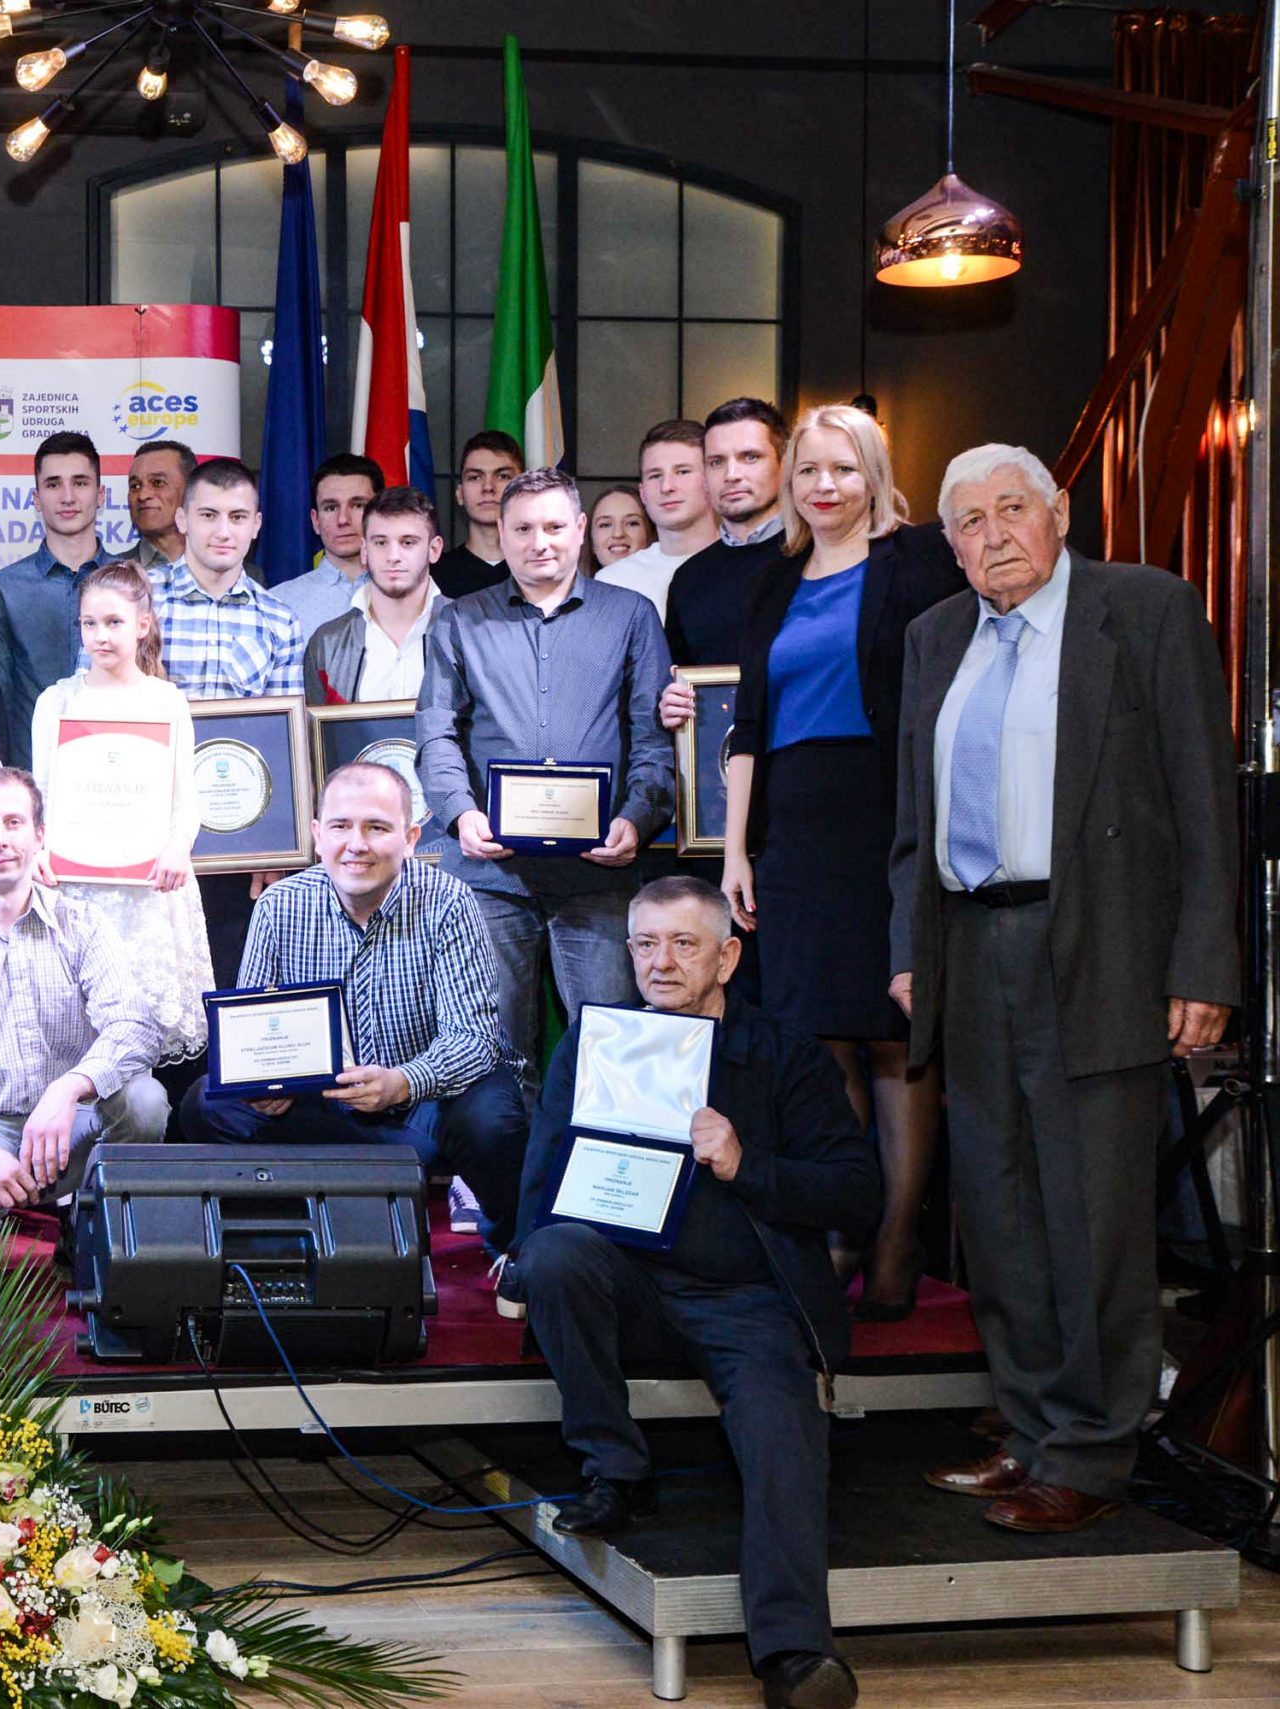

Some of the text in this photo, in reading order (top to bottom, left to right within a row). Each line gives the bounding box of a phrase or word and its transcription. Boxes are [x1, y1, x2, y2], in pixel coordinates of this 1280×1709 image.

[22, 393, 79, 402] ZAJEDNICA
[128, 395, 198, 412] aces
[22, 405, 79, 414] SPORTSKIH
[22, 417, 65, 426] UDRUGA
[127, 413, 198, 429] europe
[94, 1400, 130, 1413] BÜTEC
